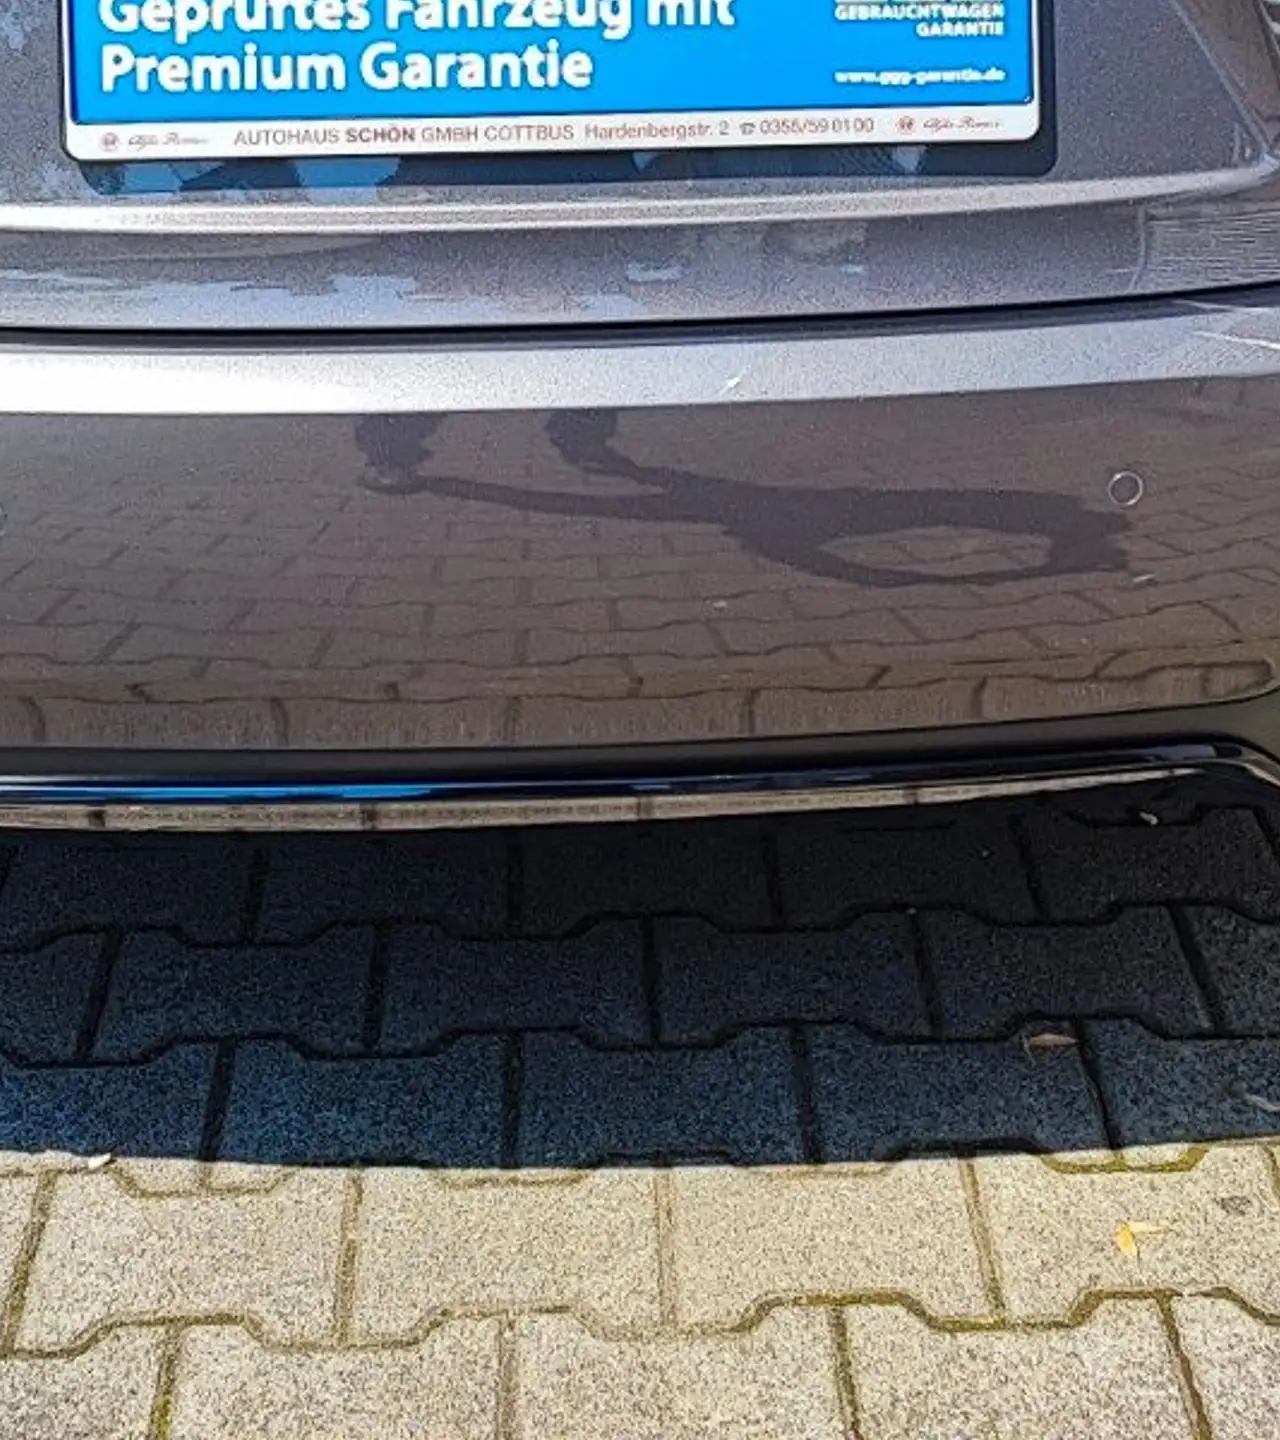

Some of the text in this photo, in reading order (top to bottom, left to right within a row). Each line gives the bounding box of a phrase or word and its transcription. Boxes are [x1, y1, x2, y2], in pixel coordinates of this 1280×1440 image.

[834, 3, 1005, 20] GEBRAUCHTWAGEN
[916, 21, 1005, 37] GARANTIE
[101, 38, 593, 92] Premium Garantie
[234, 127, 340, 146] AUTOHAUS
[345, 123, 416, 143] SCHÖN
[484, 124, 575, 142] COTTBUS
[584, 121, 713, 140] Hardenbergstr.
[719, 119, 730, 136] 2
